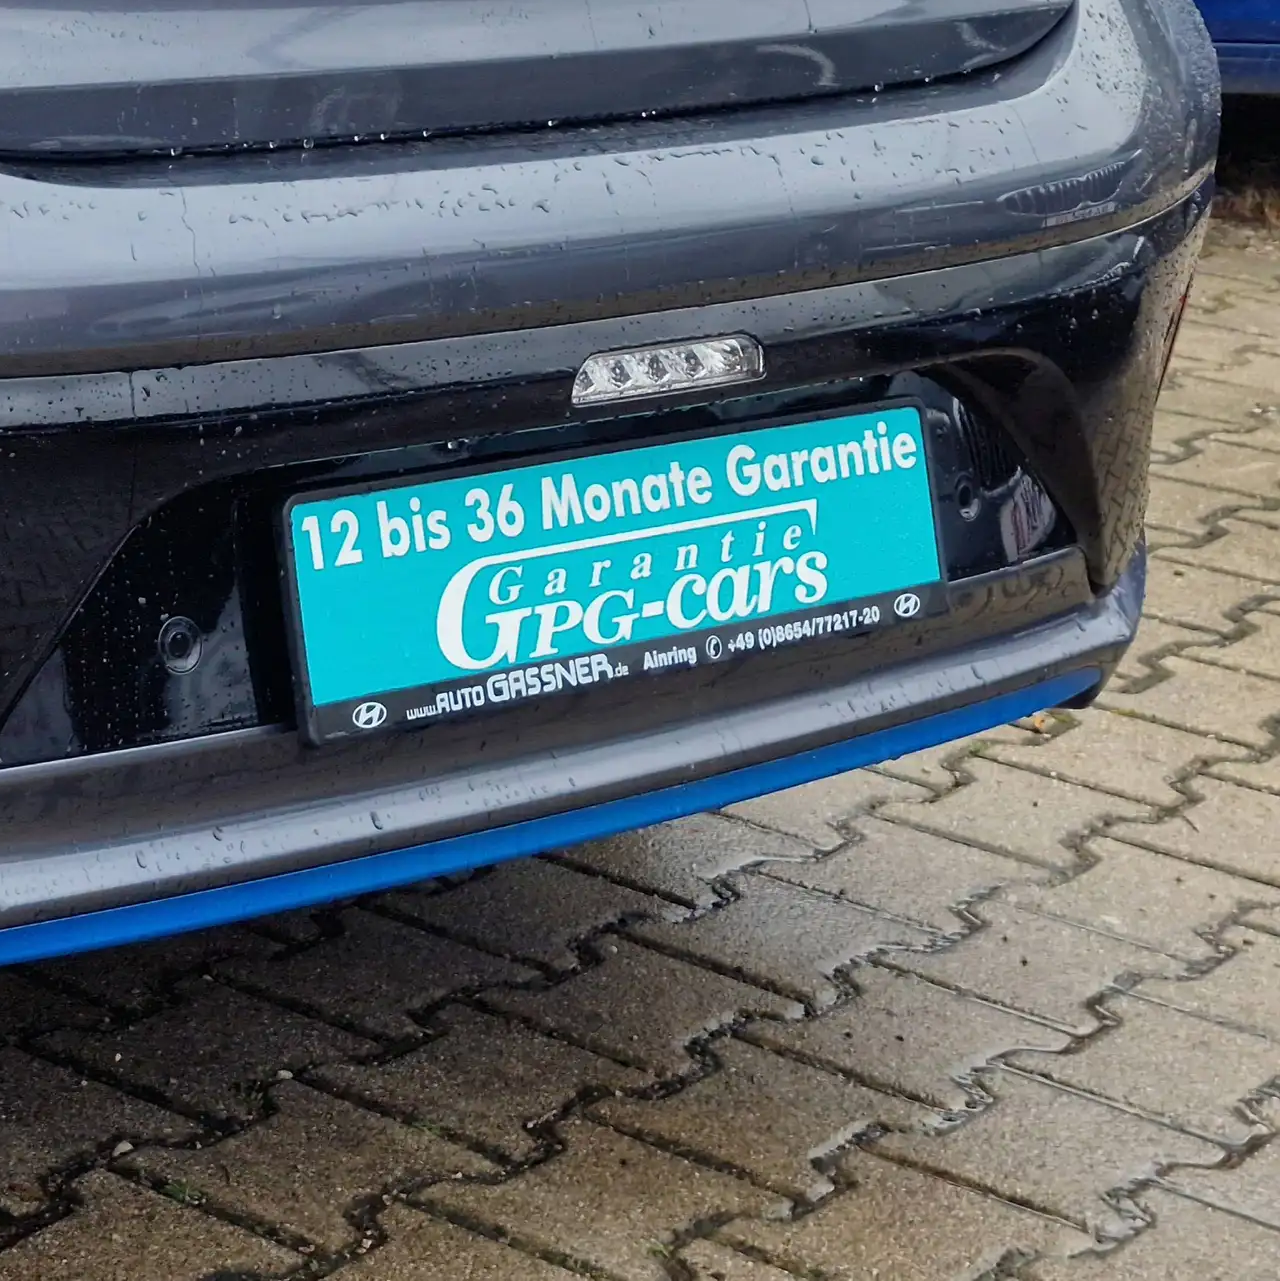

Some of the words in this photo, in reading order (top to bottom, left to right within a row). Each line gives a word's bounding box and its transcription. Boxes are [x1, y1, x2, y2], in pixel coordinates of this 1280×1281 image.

[301, 509, 363, 570] 12
[376, 497, 451, 558] bis
[464, 483, 525, 543] 36
[541, 461, 712, 530] Monate
[726, 421, 917, 497] Garantie
[436, 550, 829, 670] GPG-cars
[488, 520, 803, 606] Garantie
[643, 645, 697, 670] Ainring
[727, 631, 755, 653] +49
[758, 605, 881, 650] (0)8654/77217-20
